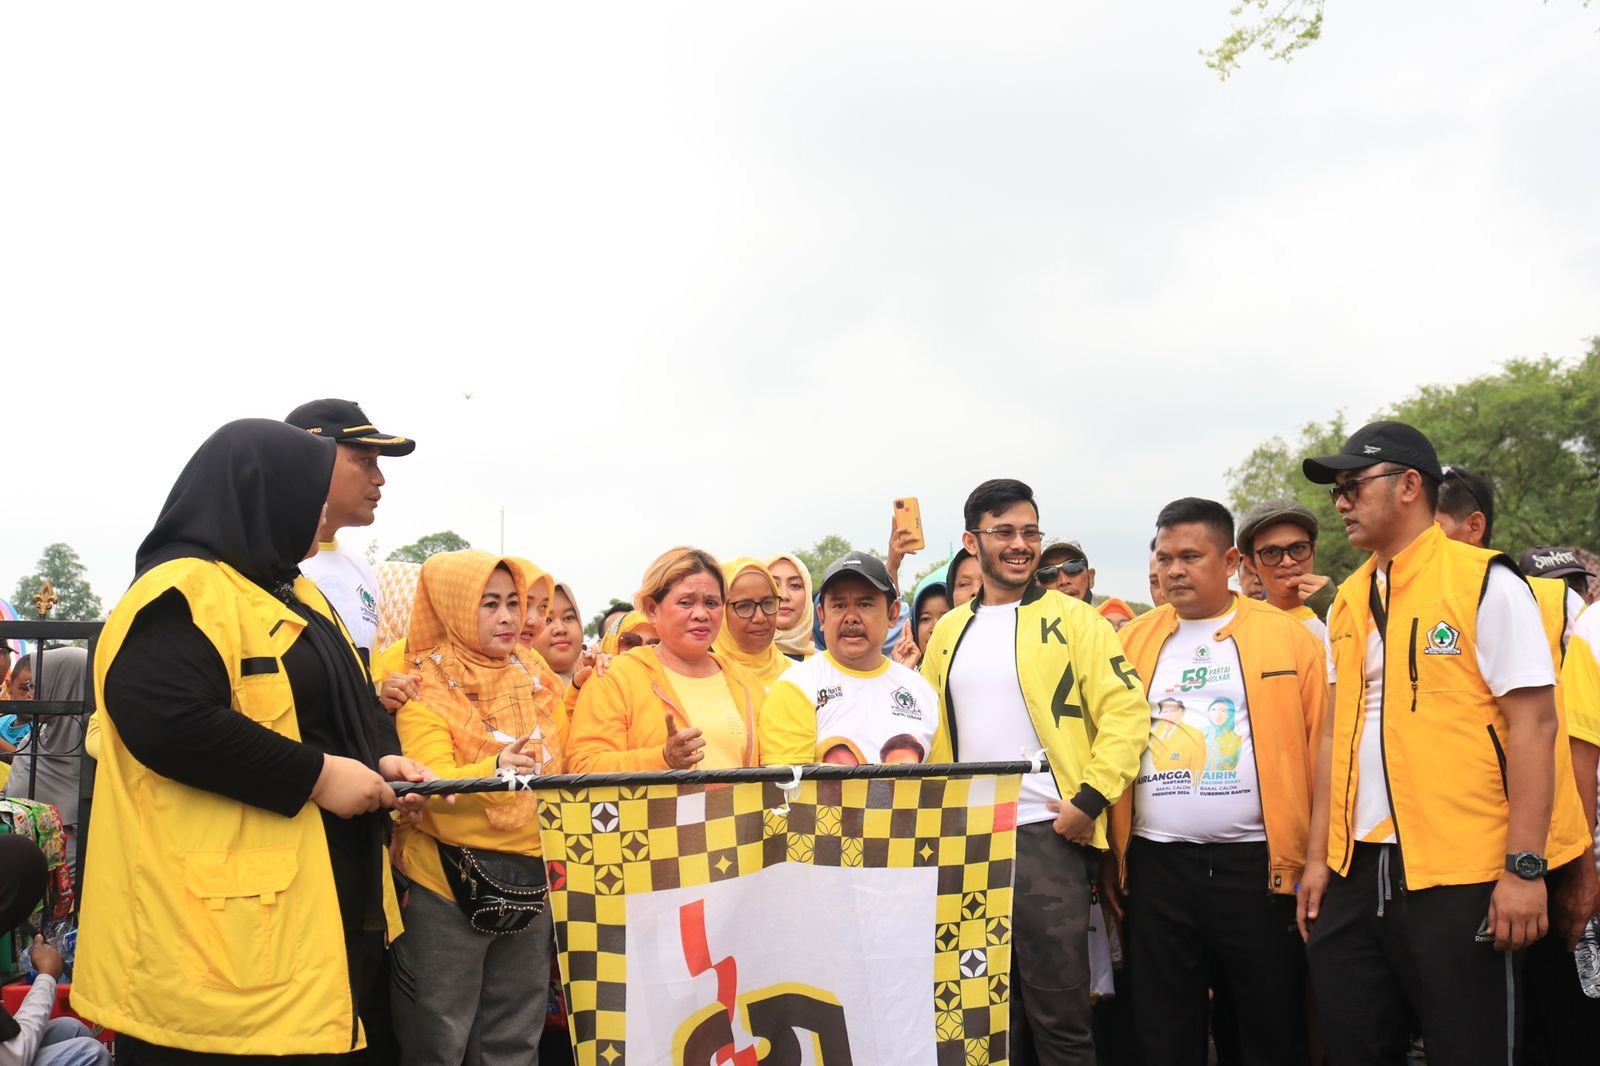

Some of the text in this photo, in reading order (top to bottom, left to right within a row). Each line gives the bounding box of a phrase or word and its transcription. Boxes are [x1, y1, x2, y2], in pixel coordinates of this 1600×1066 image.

[1040, 616, 1066, 645] K
[1180, 666, 1209, 693] 58
[1136, 770, 1191, 785] AIRLANGGA
[1202, 771, 1237, 780] AIRIN
